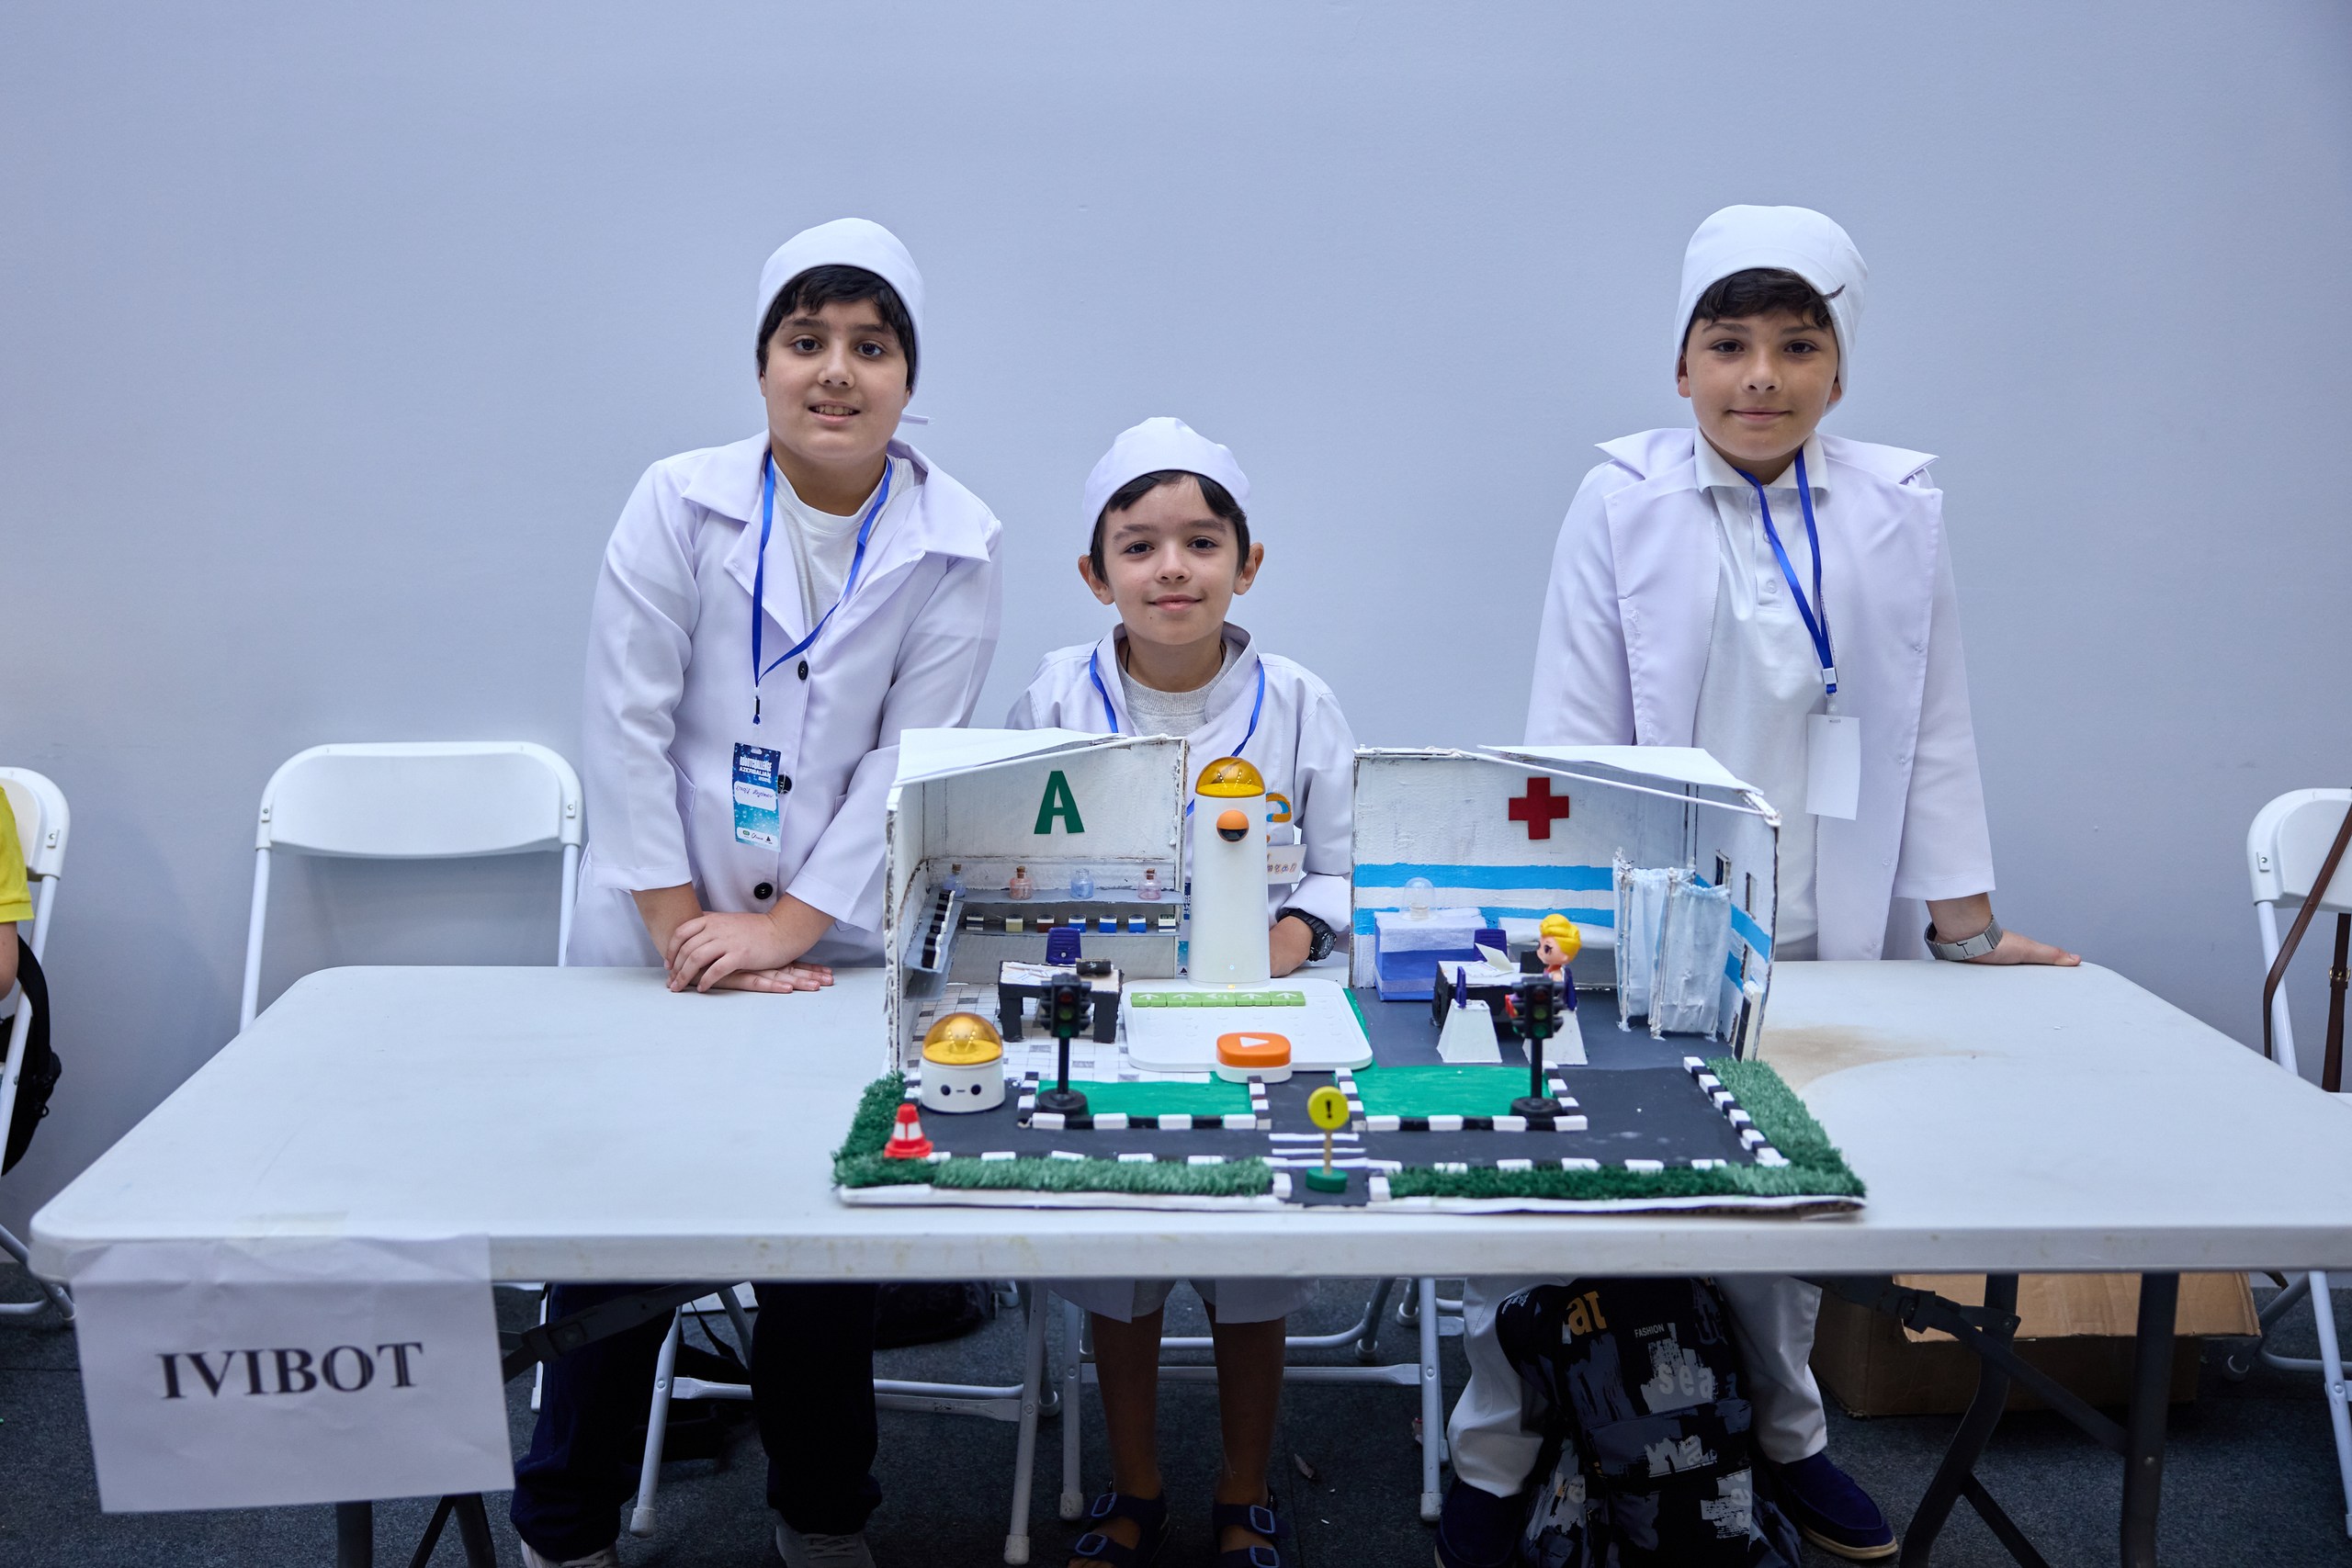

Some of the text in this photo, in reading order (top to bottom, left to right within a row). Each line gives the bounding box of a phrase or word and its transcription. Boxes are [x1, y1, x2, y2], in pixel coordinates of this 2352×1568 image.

[1034, 770, 1085, 834] A
[1634, 1324, 1665, 1338] FASHION
[156, 1341, 424, 1399] IVIBOT
